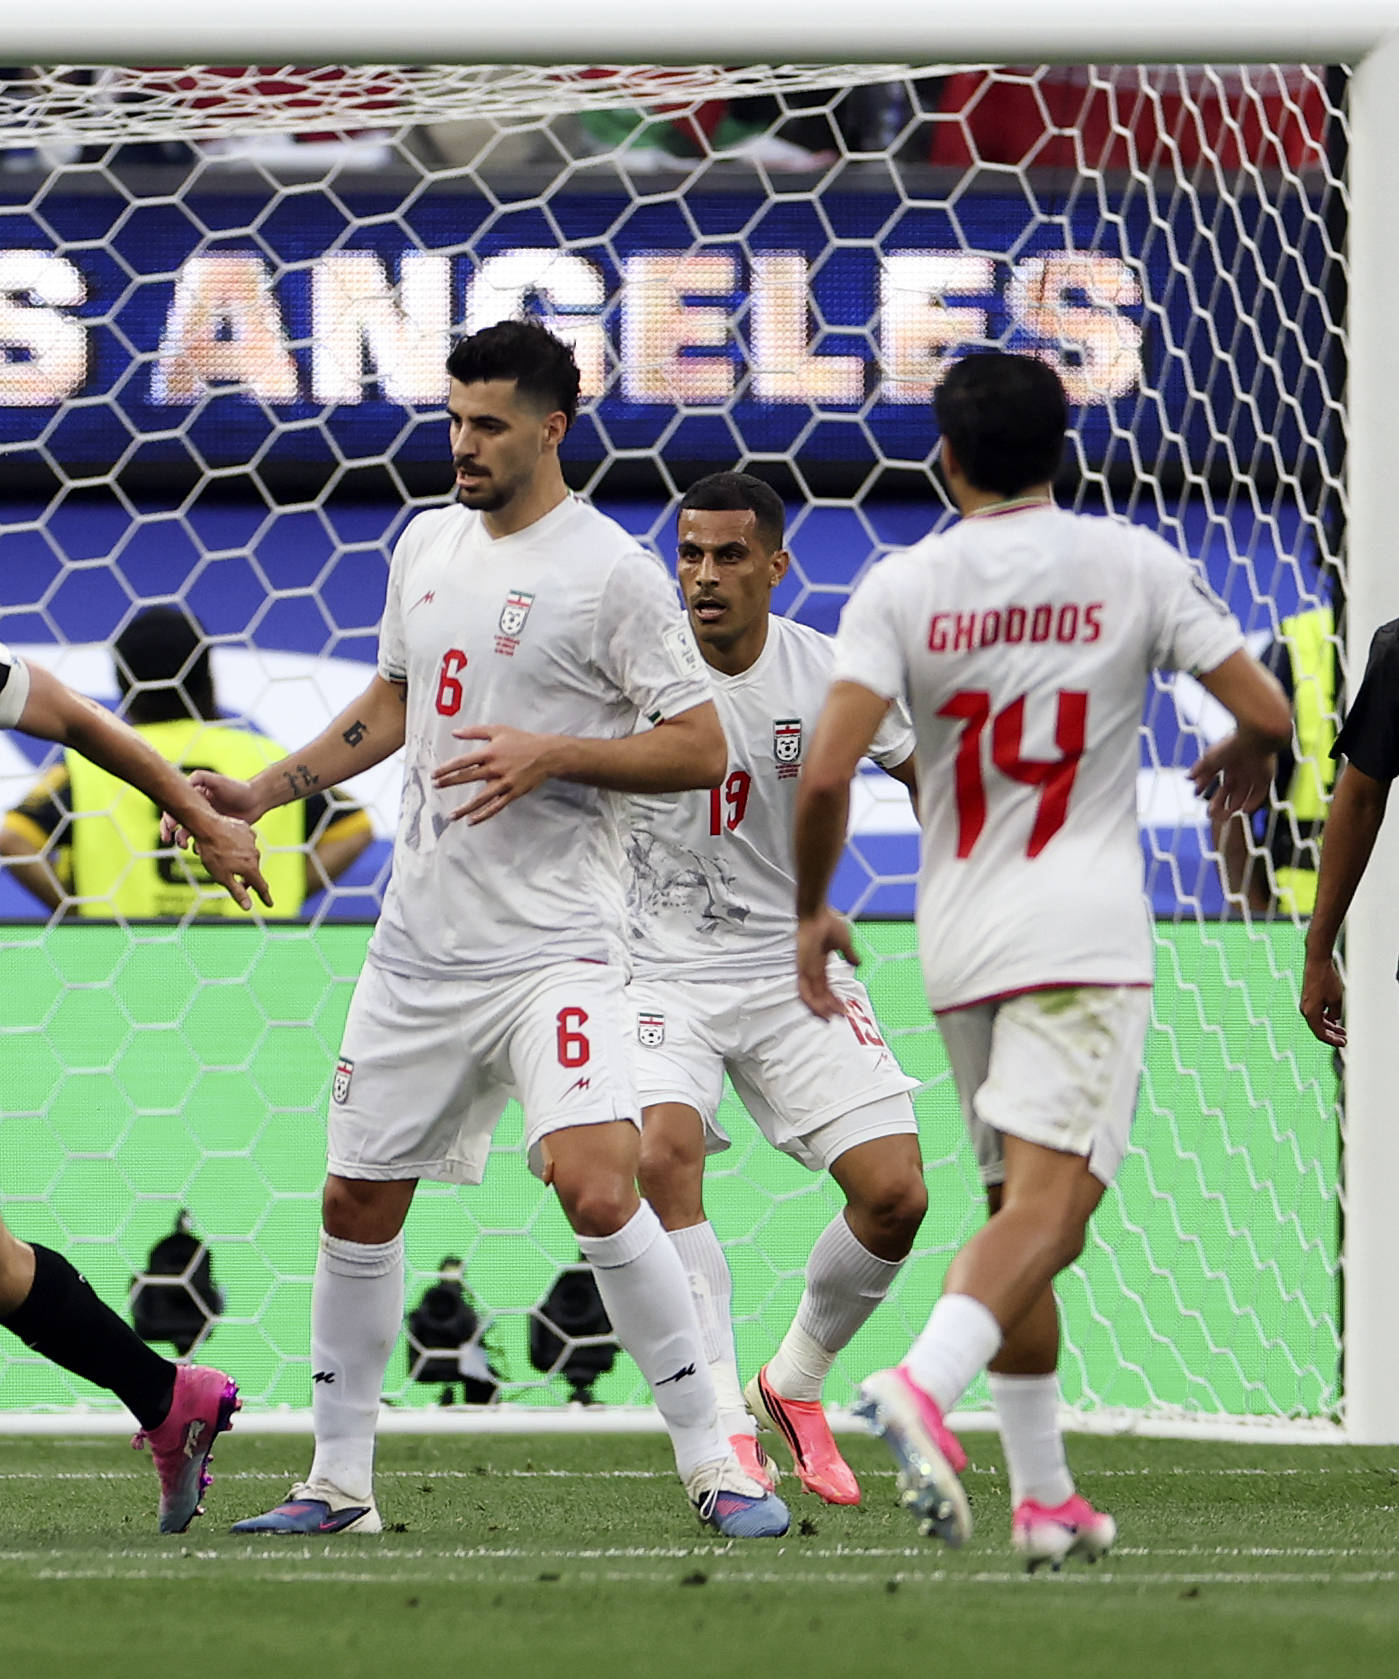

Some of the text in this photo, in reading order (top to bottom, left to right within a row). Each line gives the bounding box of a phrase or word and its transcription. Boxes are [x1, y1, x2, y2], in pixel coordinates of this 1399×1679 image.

[149, 248, 1142, 406] ANGELES
[927, 602, 1104, 652] GHODDOS
[436, 648, 468, 717] 6
[710, 770, 752, 835] 19
[934, 687, 1089, 860] 14
[556, 1006, 590, 1068] 6
